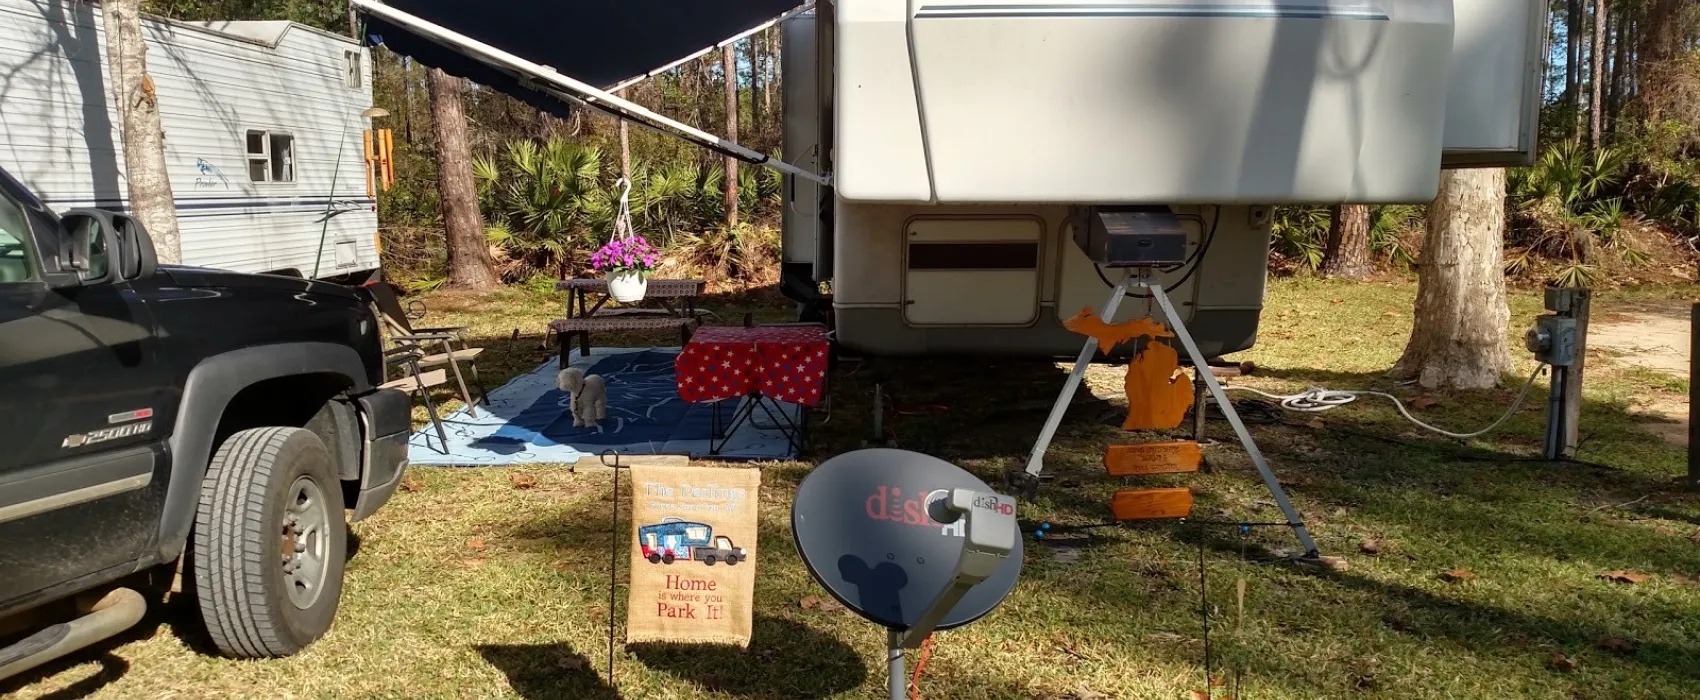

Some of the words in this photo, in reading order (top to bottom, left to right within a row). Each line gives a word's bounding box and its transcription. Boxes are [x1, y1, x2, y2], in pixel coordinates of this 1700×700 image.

[644, 482, 674, 496] The
[681, 484, 746, 502] Darlings
[666, 575, 717, 591] Home
[658, 591, 667, 600] is
[670, 592, 701, 602] where
[704, 596, 723, 604] you
[657, 602, 697, 619] Park
[706, 604, 724, 619] It!
